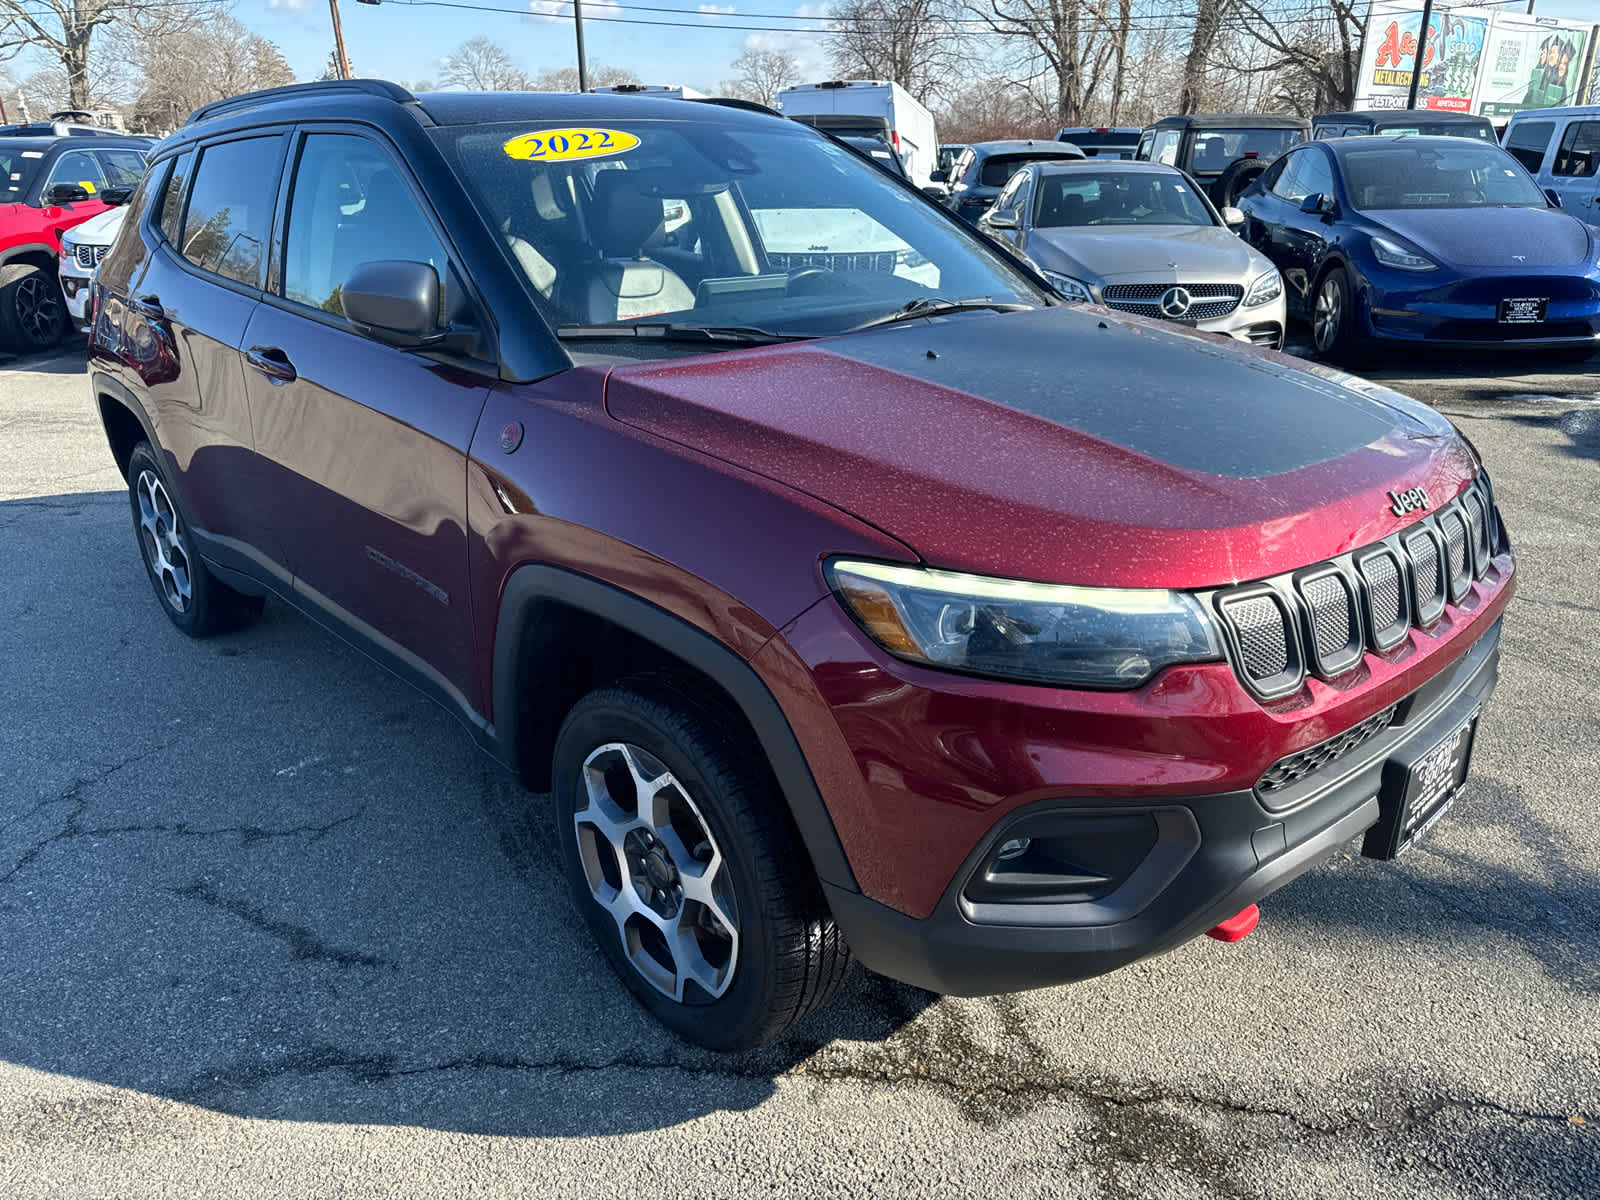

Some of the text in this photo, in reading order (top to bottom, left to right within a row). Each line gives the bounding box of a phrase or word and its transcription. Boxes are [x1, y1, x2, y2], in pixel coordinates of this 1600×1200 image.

[1373, 70, 1394, 85] METAL
[1368, 95, 1408, 109] WESTPORT
[524, 131, 615, 158] 2022
[807, 243, 829, 252] Jeep
[1386, 485, 1430, 518] Jeep
